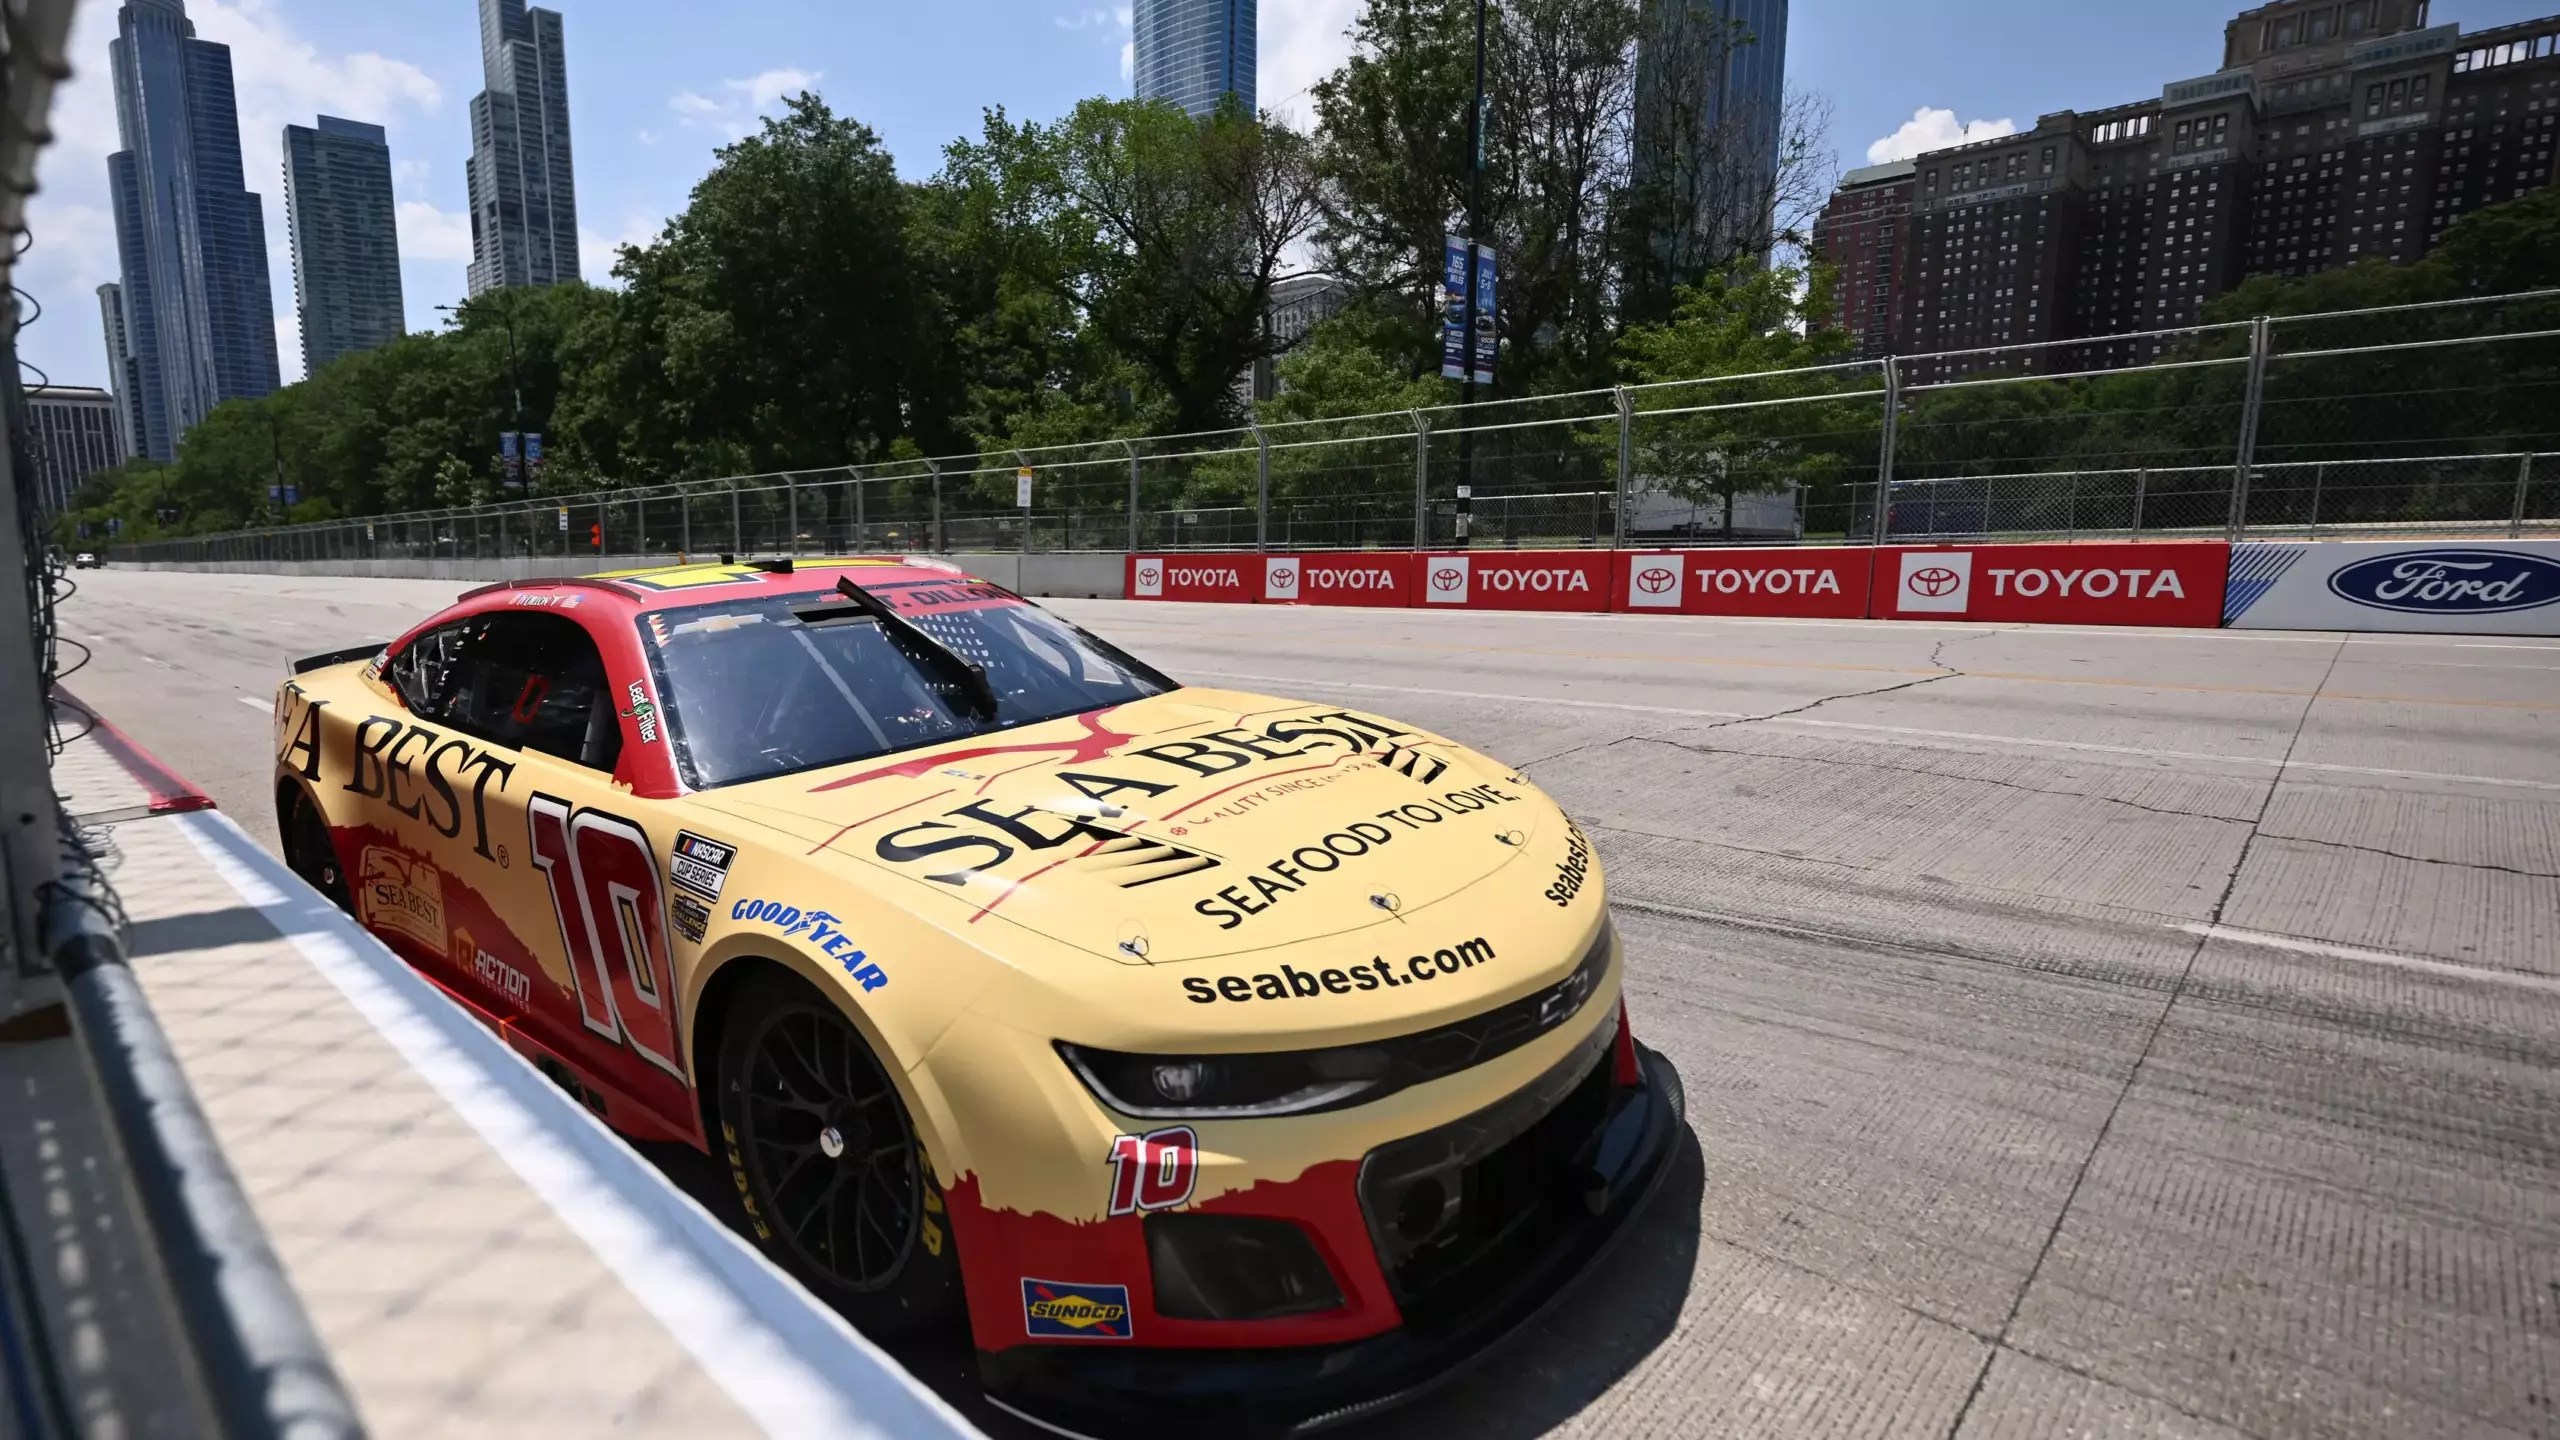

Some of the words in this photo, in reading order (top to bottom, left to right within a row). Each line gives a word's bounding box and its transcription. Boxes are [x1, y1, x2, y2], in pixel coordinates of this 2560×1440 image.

[1452, 255, 1464, 270] 165
[1481, 268, 1493, 280] JULY
[1480, 279, 1491, 290] 5-6
[1168, 568, 1239, 588] TOYOTA
[1306, 569, 1394, 590] TOYOTA
[1477, 569, 1589, 592] TOYOTA
[1695, 568, 1841, 595] TOYOTA
[1987, 568, 2185, 599] TOYOTA
[2375, 559, 2532, 602] Ford
[908, 587, 1014, 605] DILLON
[628, 679, 650, 707] Leaf
[637, 710, 659, 744] Filter
[875, 771, 1179, 887] SEA
[1125, 712, 1411, 779] BEST
[1264, 778, 1321, 796] SINCE
[690, 841, 726, 866] NASCAR
[1194, 822, 1392, 930] SEAFOOD
[1376, 804, 1443, 830] TO
[677, 859, 694, 880] CUP
[691, 864, 718, 888] SERIES
[375, 883, 407, 909] SEA
[407, 890, 438, 927] BEST
[527, 789, 691, 1092] 10
[475, 948, 530, 1002] ACTION
[1182, 936, 1496, 1004] seabest.com
[1105, 1124, 1199, 1218] 10
[1033, 1303, 1121, 1320] SUNOCO
